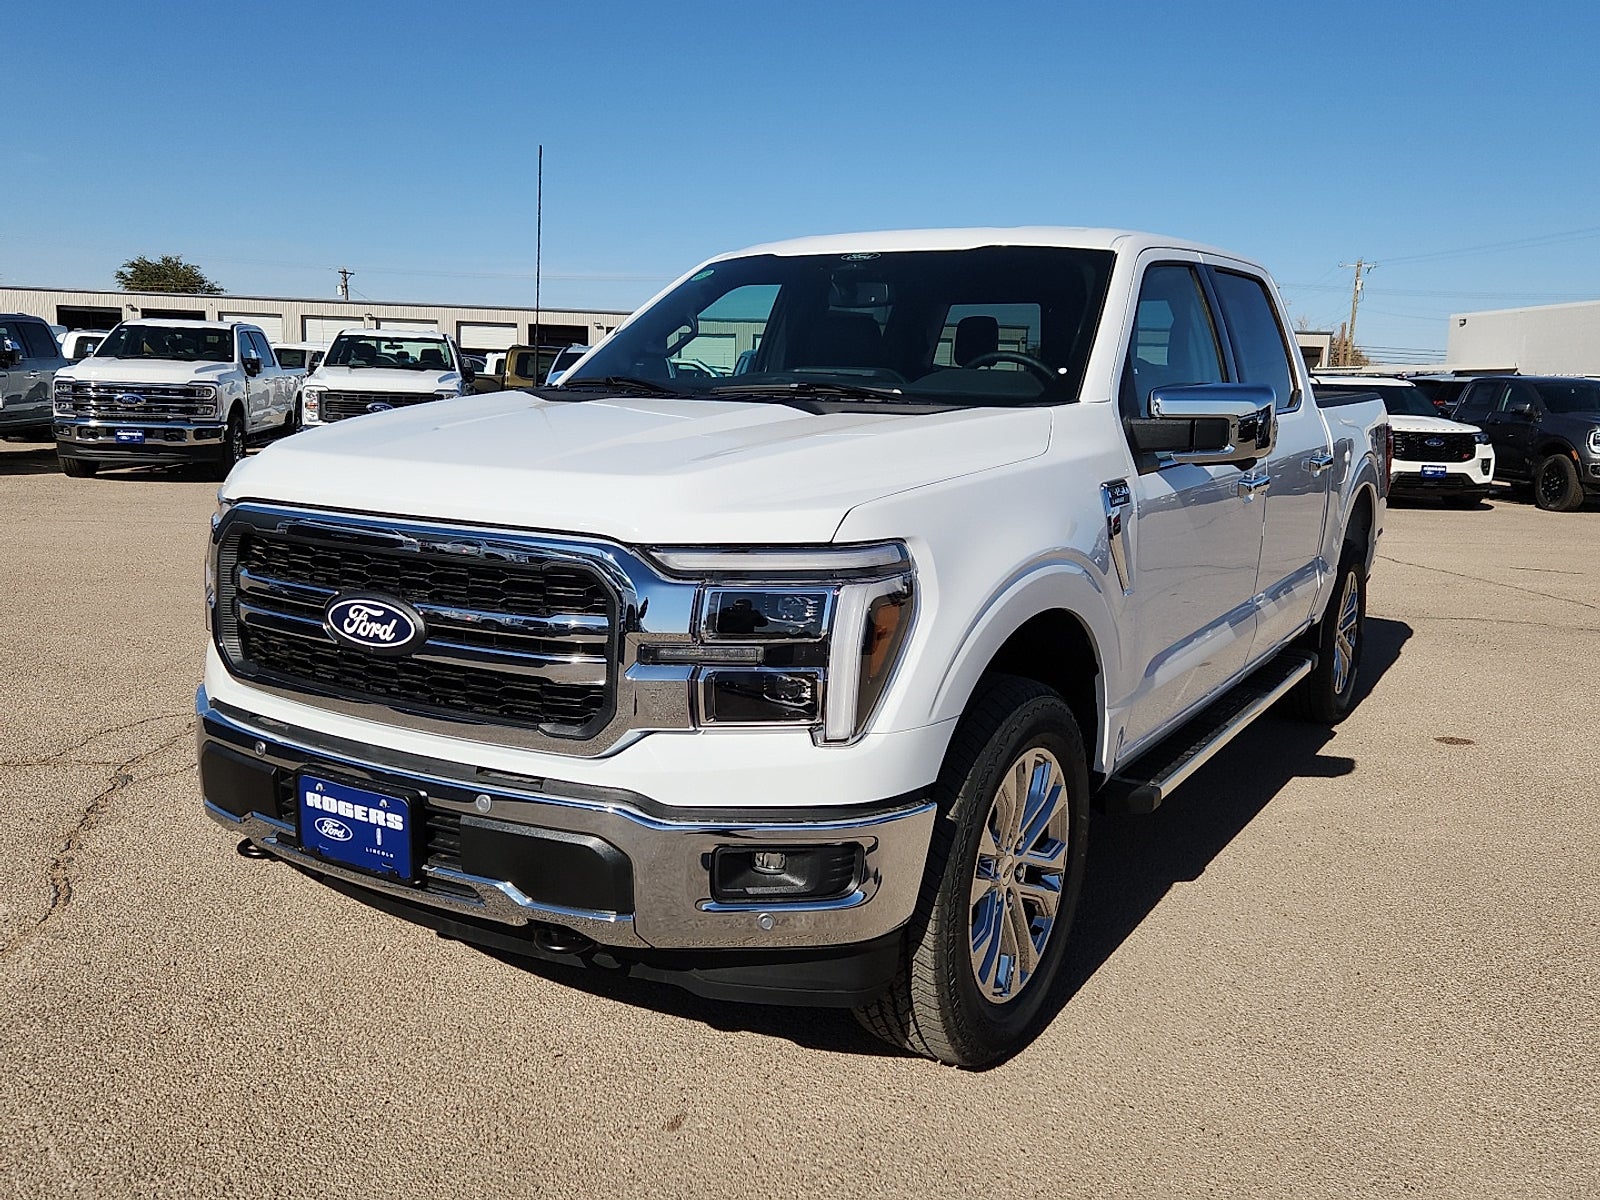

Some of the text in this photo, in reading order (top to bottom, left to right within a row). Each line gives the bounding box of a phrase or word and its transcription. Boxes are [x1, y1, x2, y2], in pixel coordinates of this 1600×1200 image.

[343, 604, 398, 641] Ford
[305, 791, 404, 831] ROGERS
[321, 820, 346, 839] Ford
